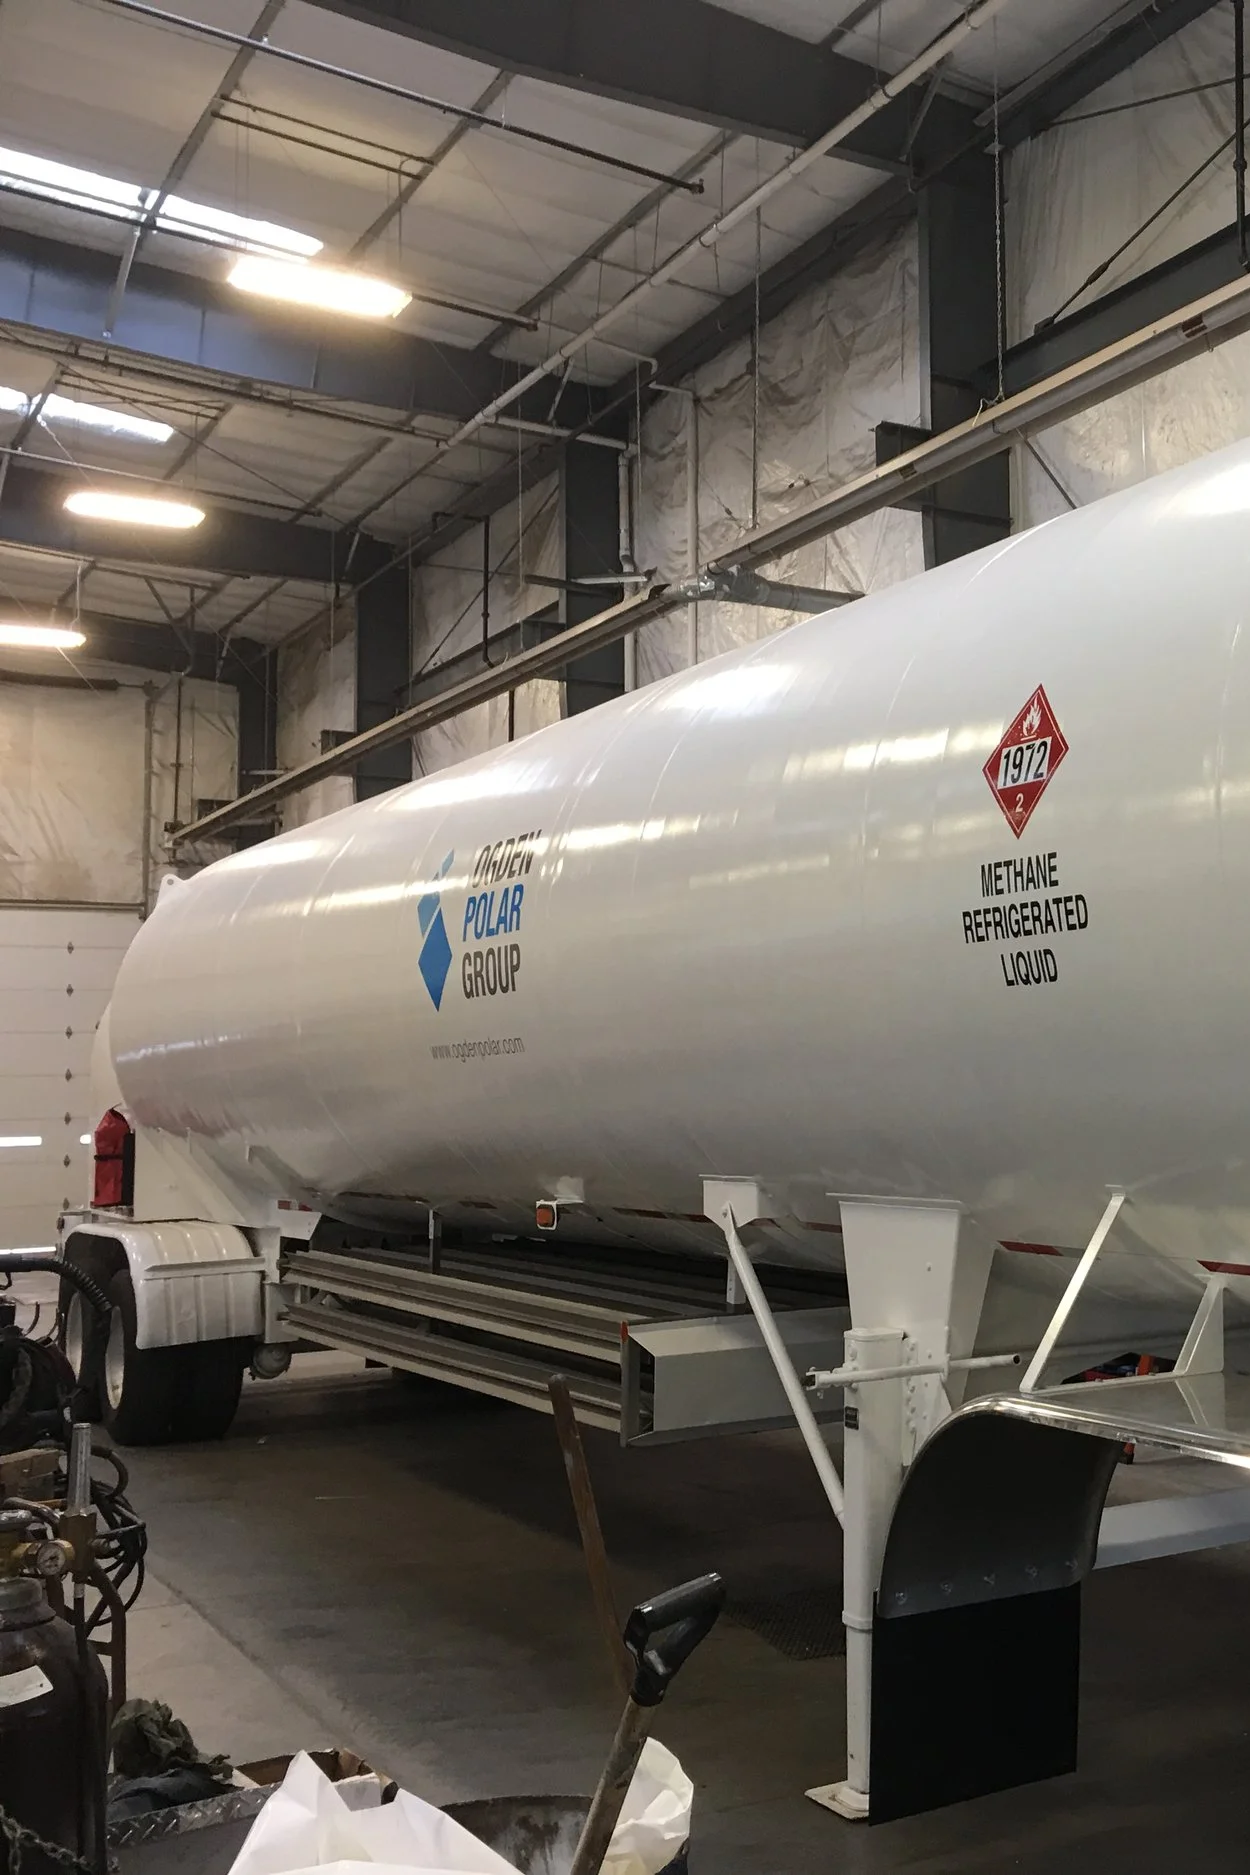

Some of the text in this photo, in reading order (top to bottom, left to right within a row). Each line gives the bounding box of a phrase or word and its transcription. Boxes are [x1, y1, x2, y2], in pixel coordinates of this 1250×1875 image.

[1002, 740, 1048, 787] 1972
[1015, 792, 1024, 813] 2
[472, 828, 542, 889] OGDEN
[981, 852, 1059, 897] METHANE
[462, 883, 524, 942] POLAR
[962, 894, 1089, 943] REFRIGERATED
[461, 943, 521, 999] GROUP
[1000, 948, 1058, 987] LIQUID
[430, 1036, 525, 1064] www.ogdenpolar.com
